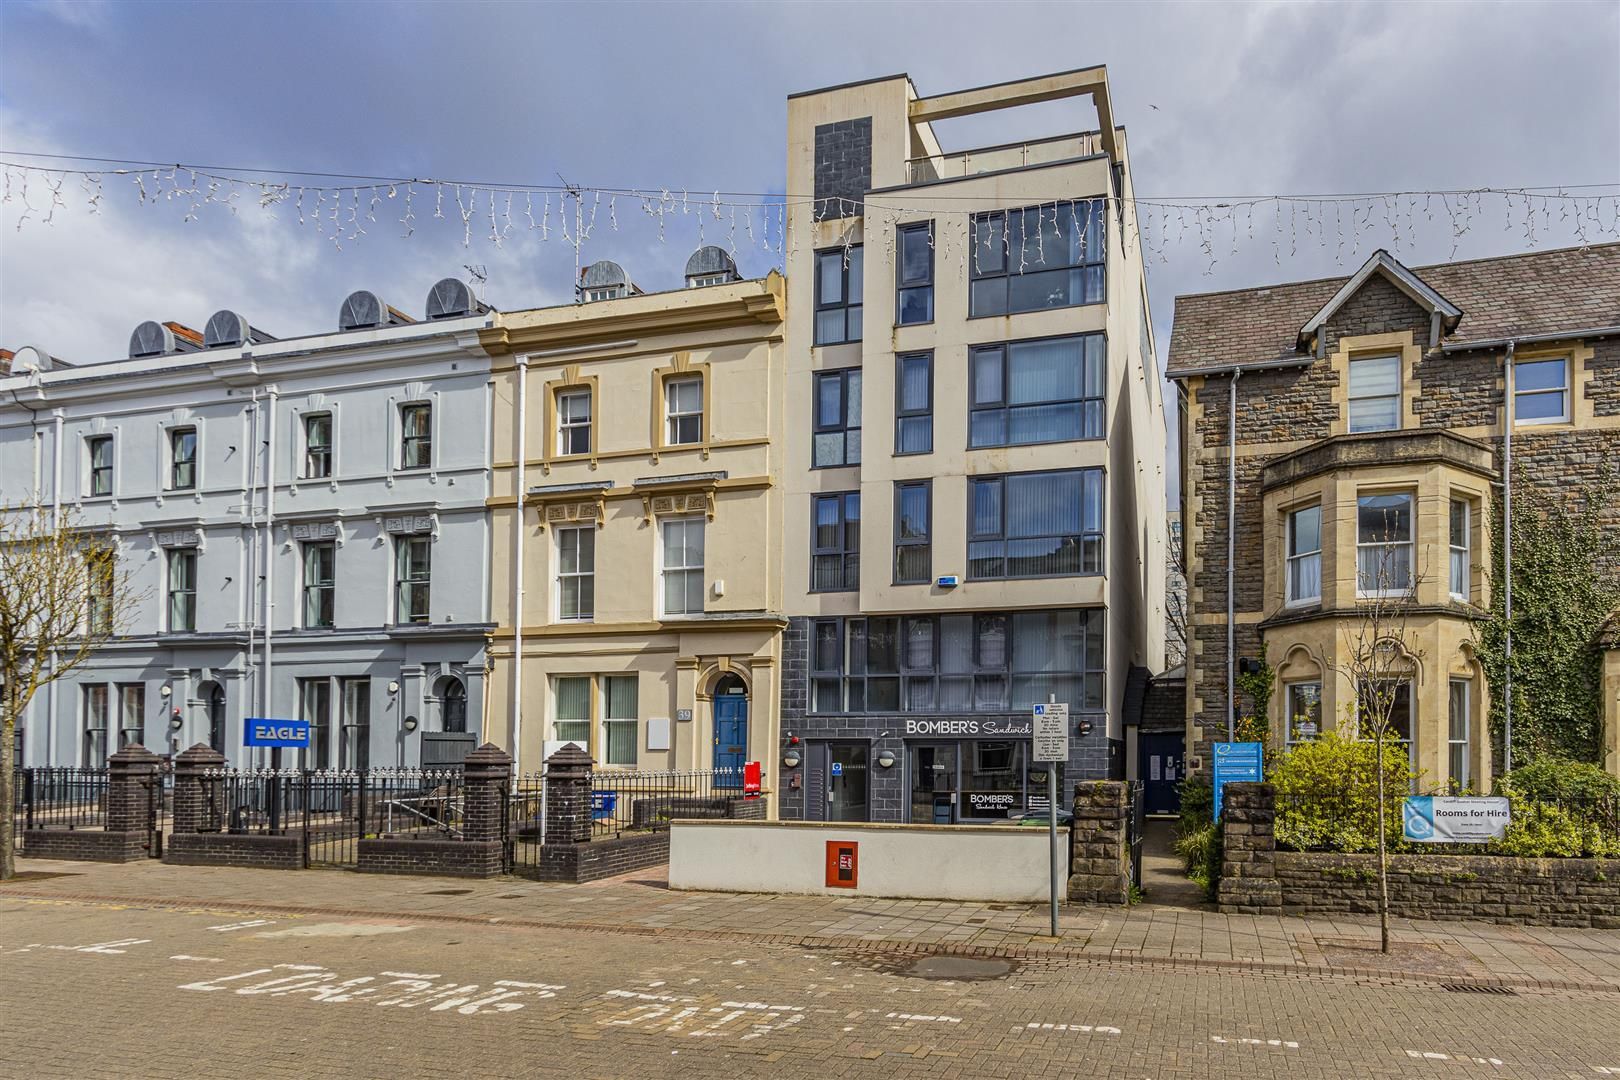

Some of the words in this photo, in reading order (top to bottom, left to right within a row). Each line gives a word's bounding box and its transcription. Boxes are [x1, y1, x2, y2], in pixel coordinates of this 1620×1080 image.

[679, 710, 691, 720] 39
[906, 720, 979, 734] BOMBER'S
[982, 721, 1032, 734] Sandwich
[256, 726, 306, 740] EAGLE
[970, 794, 1014, 803] BOMBER'S
[1436, 809, 1468, 817] Rooms
[1470, 809, 1484, 817] for
[1487, 809, 1507, 817] Hire
